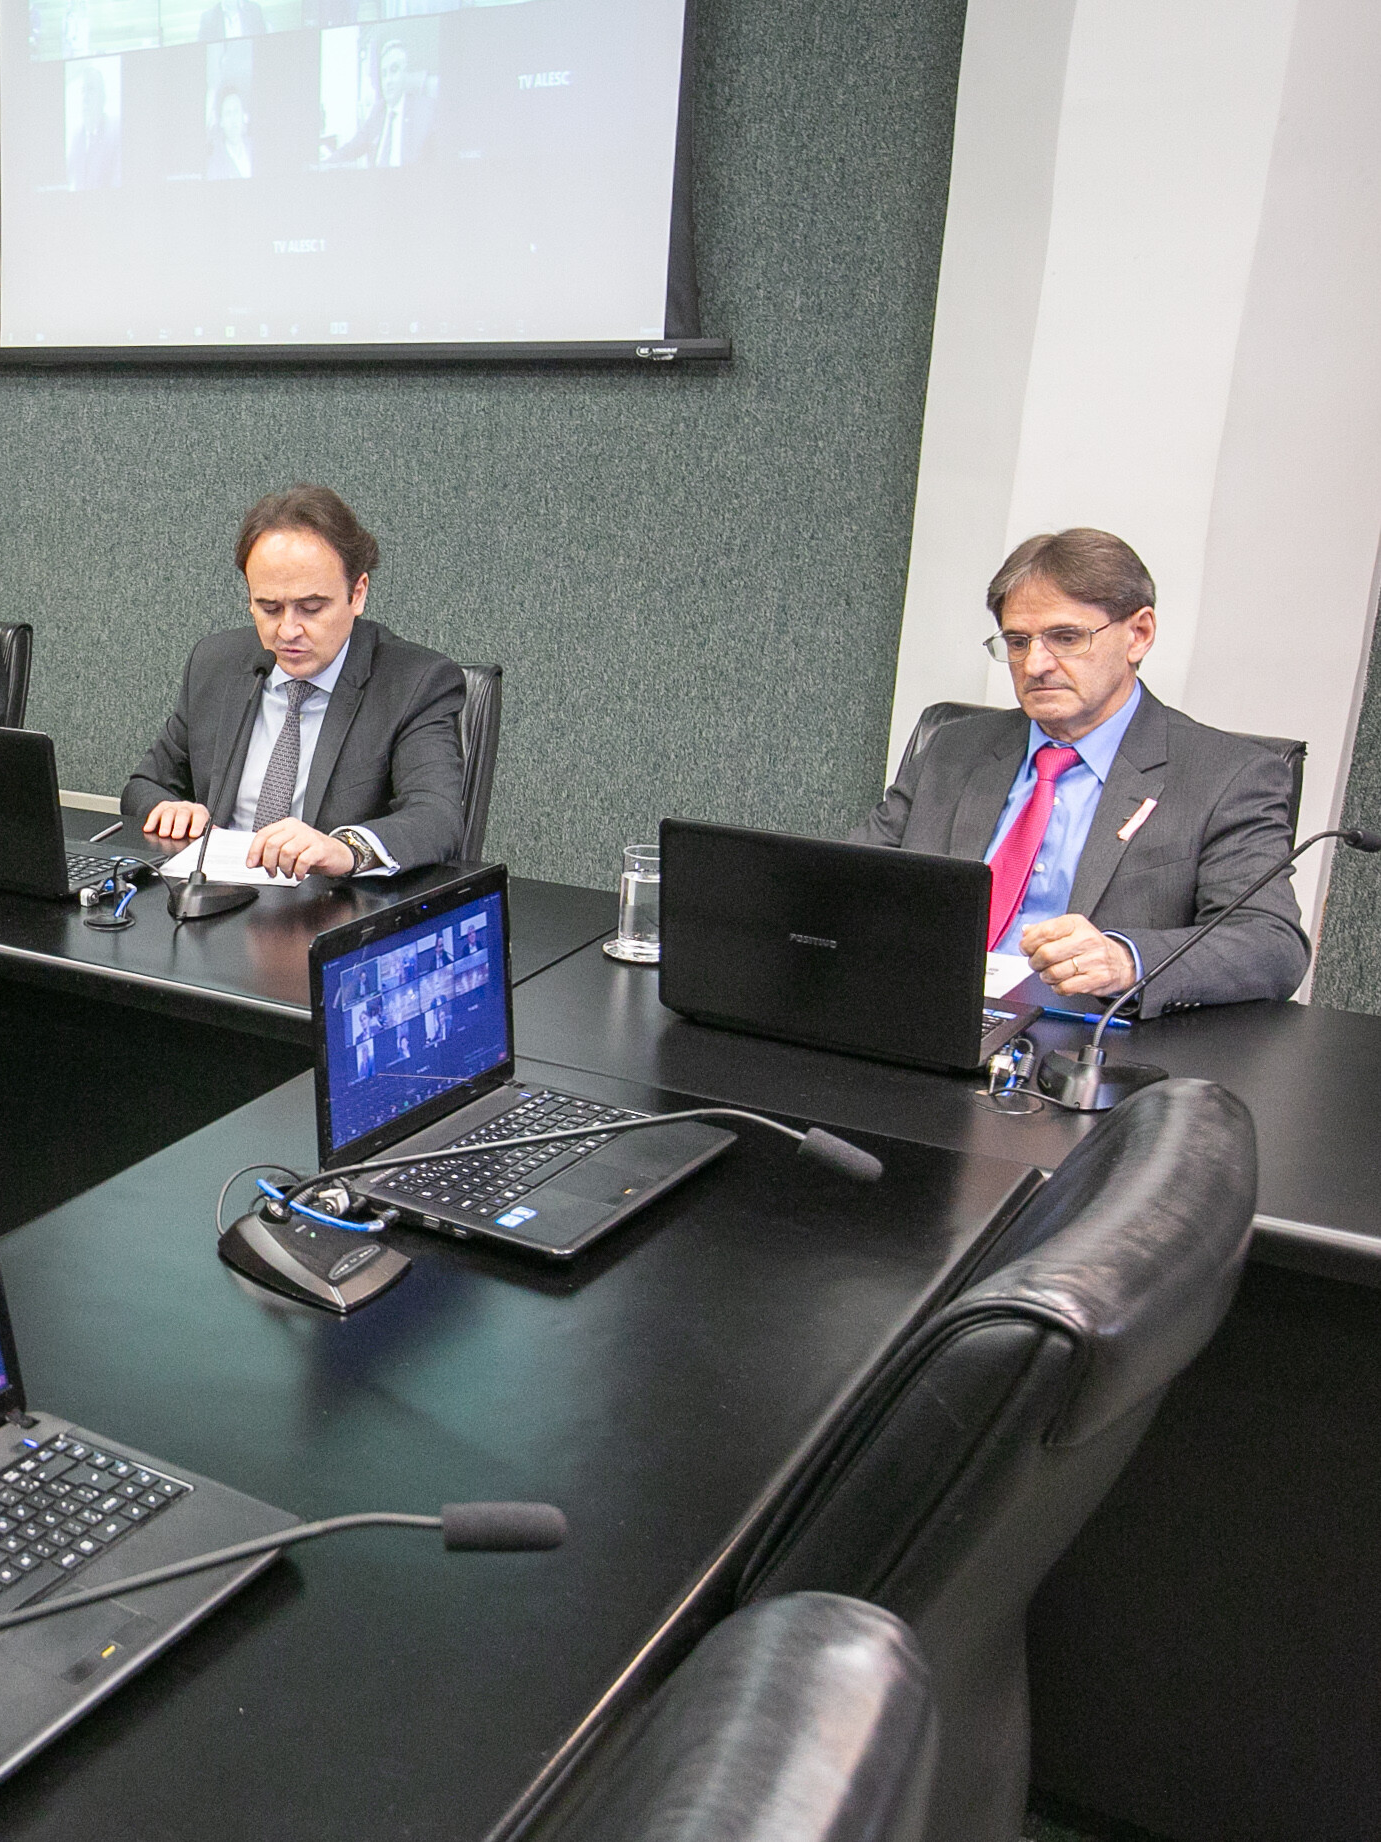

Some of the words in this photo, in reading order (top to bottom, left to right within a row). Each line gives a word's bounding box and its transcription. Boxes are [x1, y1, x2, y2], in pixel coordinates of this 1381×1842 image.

[517, 73, 535, 90] TV
[533, 70, 571, 88] ALESC
[272, 240, 287, 253] TV
[287, 239, 319, 253] ALESC
[789, 932, 838, 949] POSITIVO
